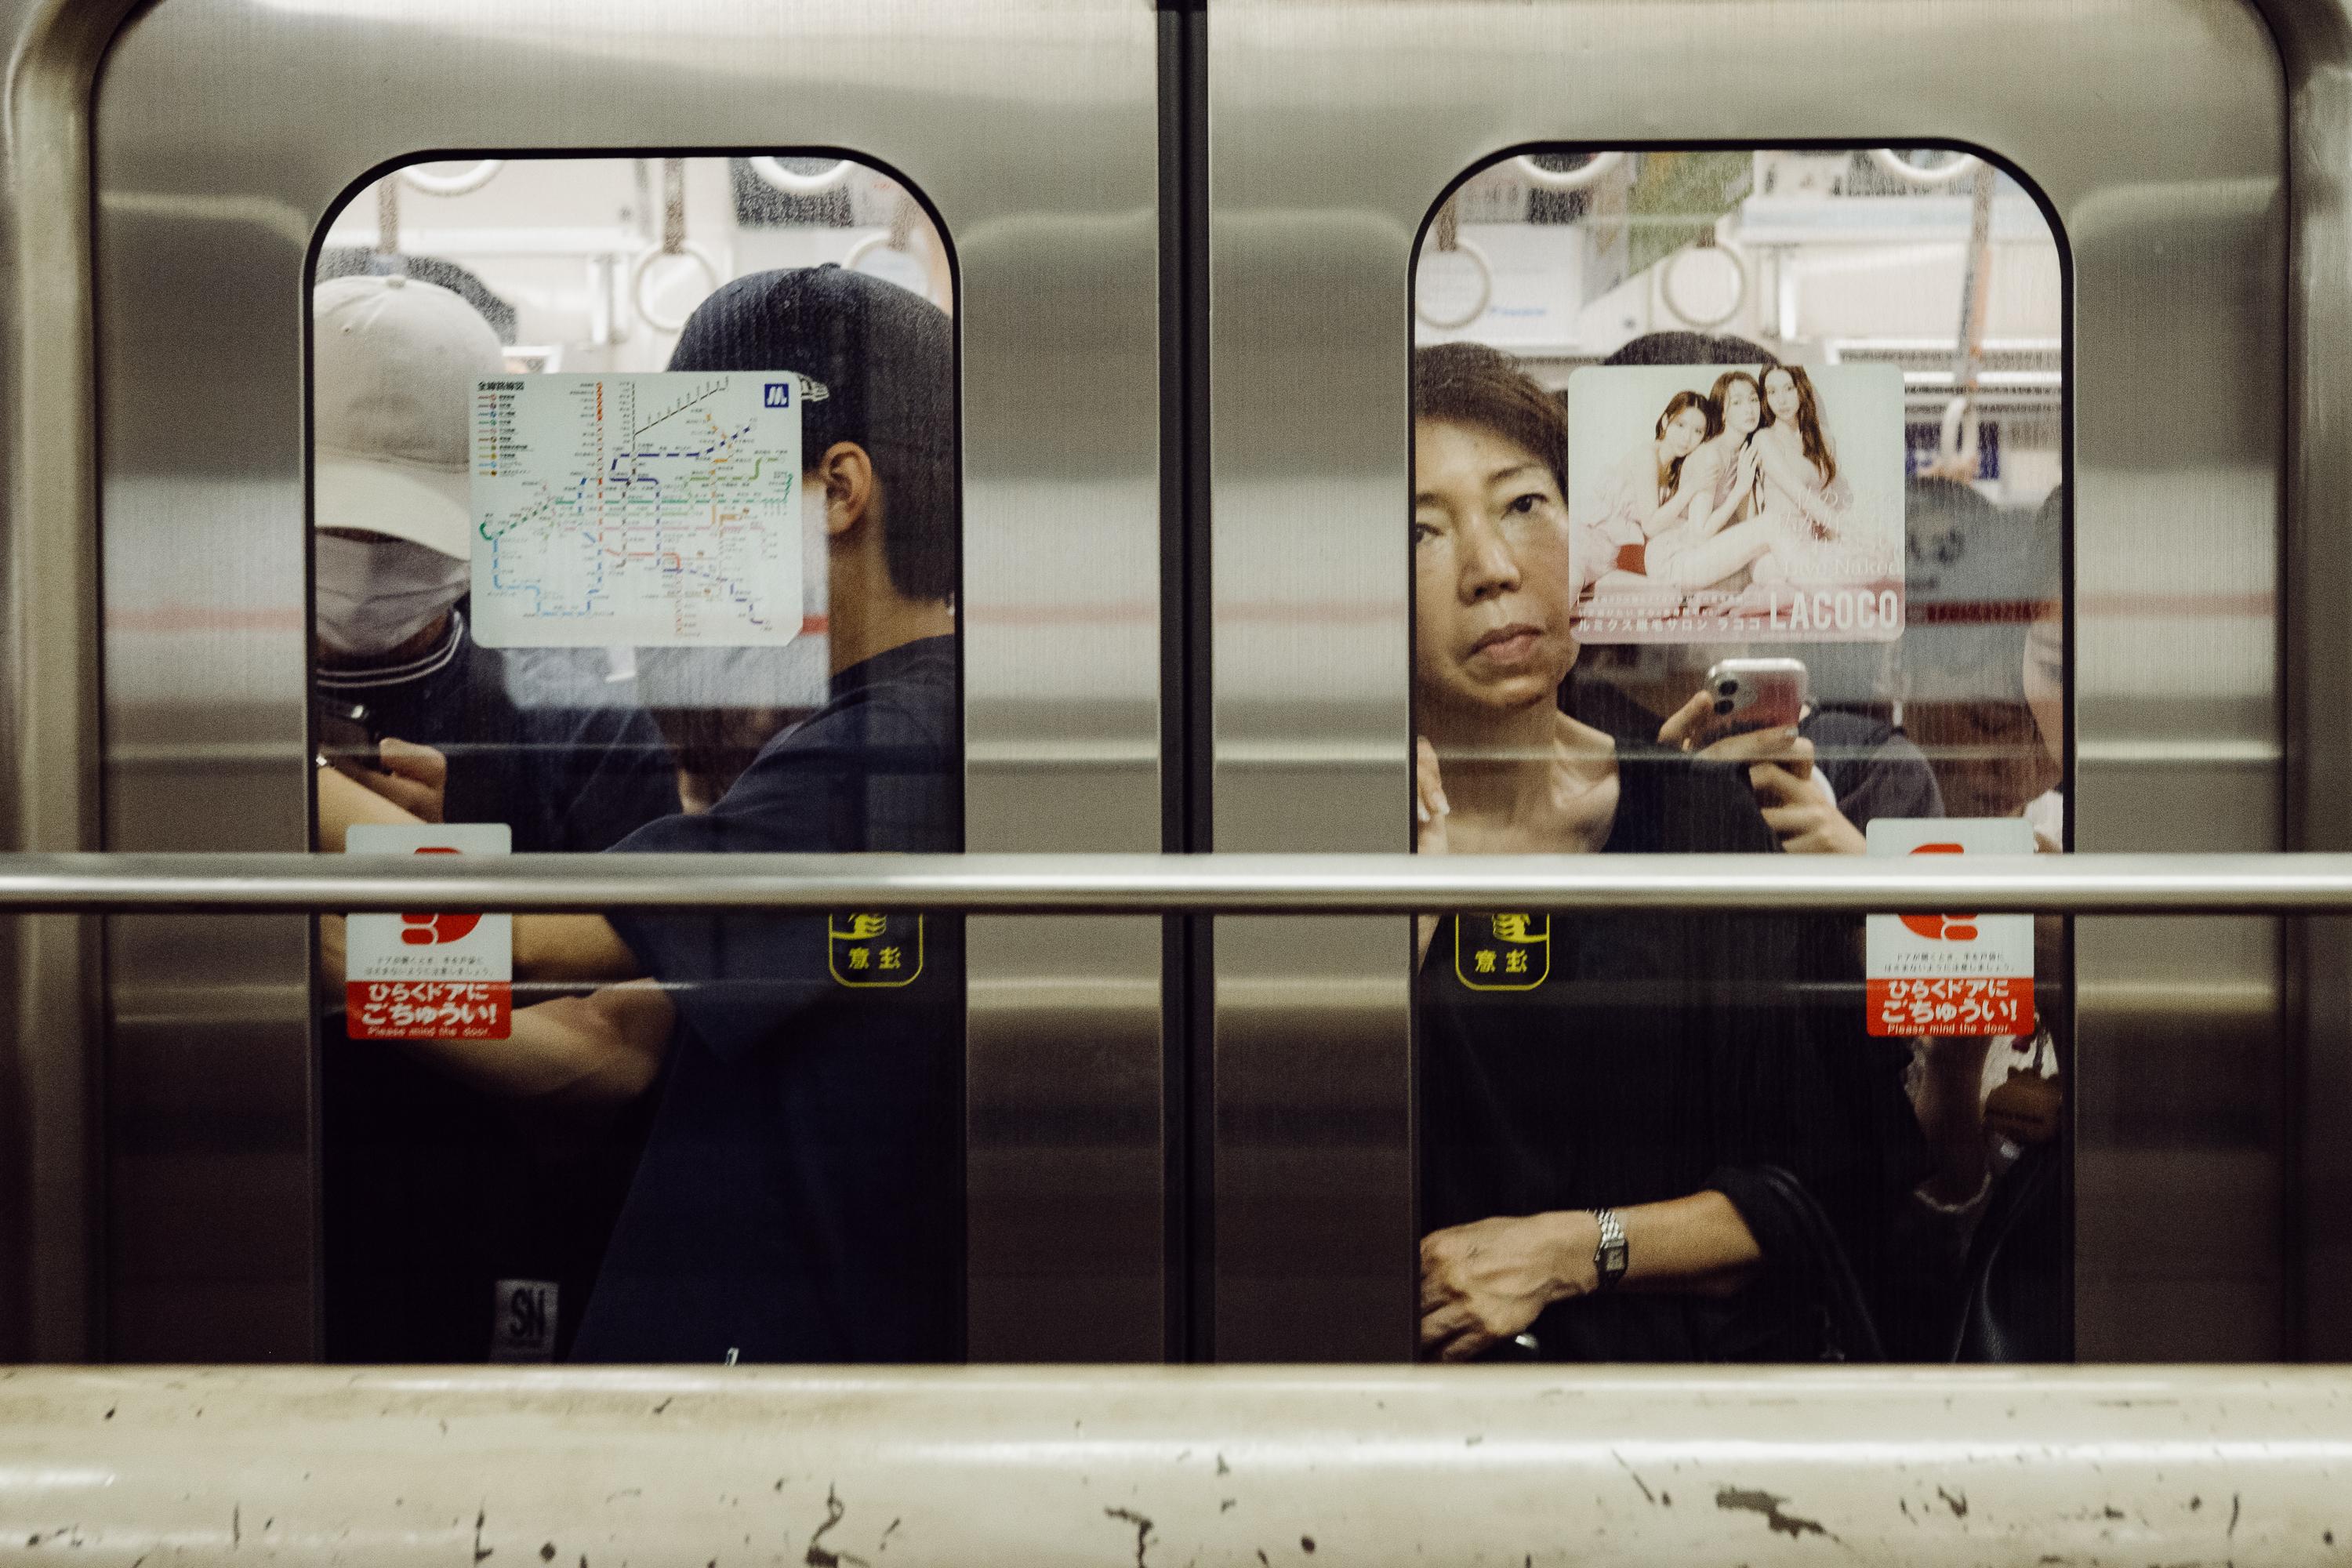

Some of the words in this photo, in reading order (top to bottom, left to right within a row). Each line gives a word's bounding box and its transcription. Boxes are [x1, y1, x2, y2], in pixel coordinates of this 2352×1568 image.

[1769, 590, 1898, 631] LACOCO
[1718, 618, 1761, 632] ラココ
[368, 982, 490, 1003] ひらくドアに
[1888, 979, 2010, 1000] ひらくドアに
[366, 1025, 407, 1037] Please
[408, 1026, 437, 1037] mind
[438, 1026, 458, 1037] the
[1887, 1022, 1925, 1035] Please
[1929, 1023, 1956, 1035] mind
[1959, 1023, 1977, 1035] the
